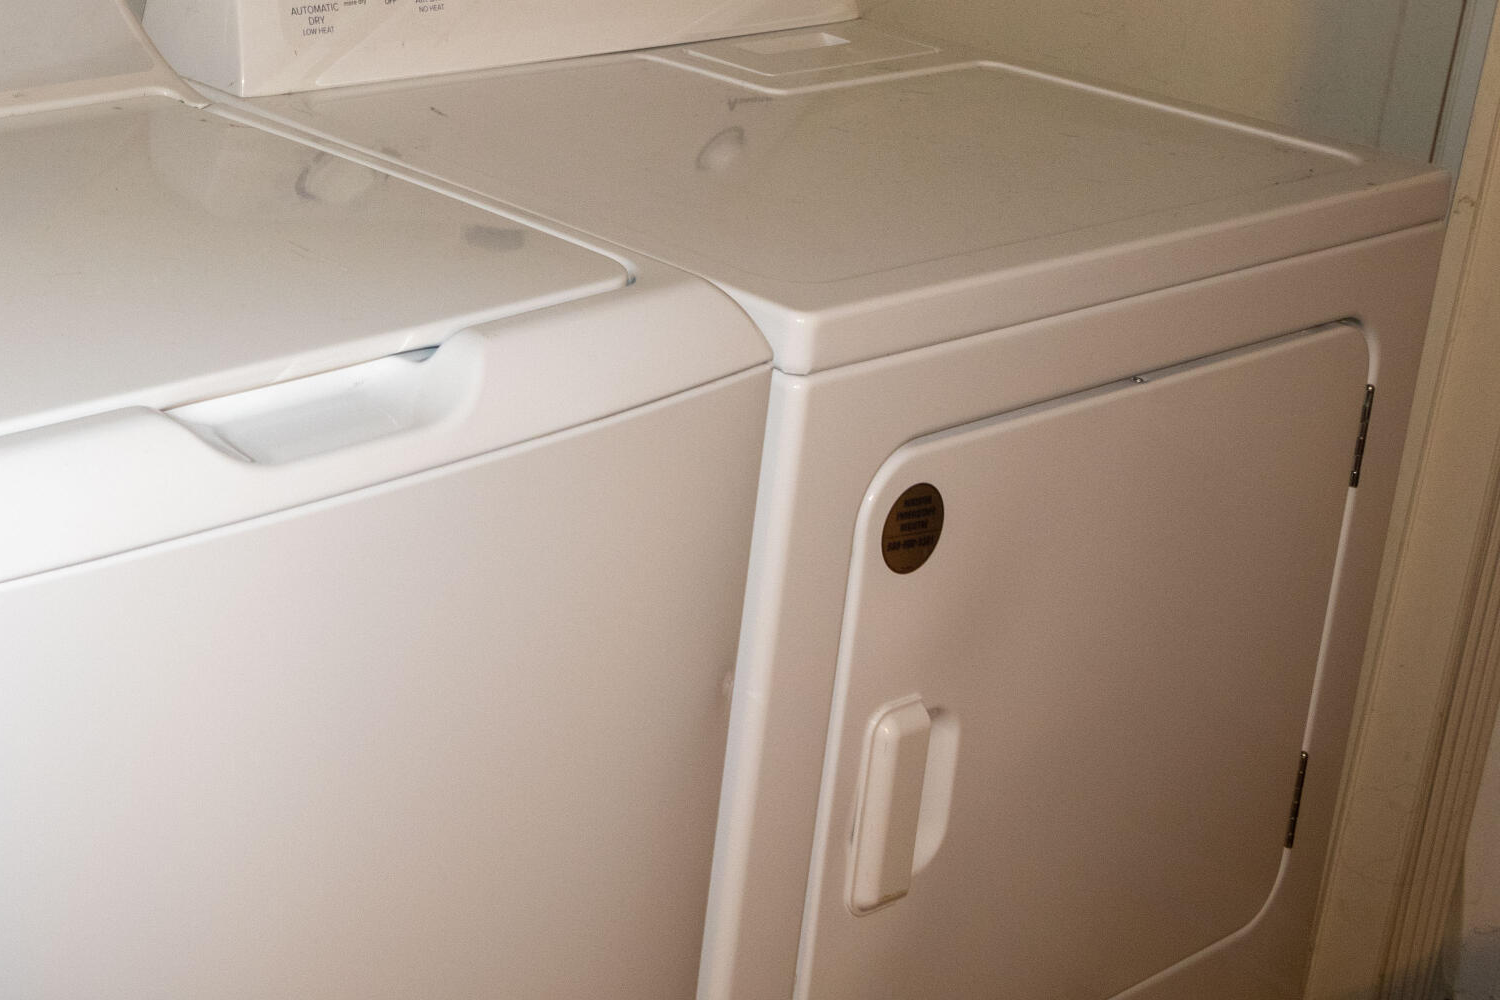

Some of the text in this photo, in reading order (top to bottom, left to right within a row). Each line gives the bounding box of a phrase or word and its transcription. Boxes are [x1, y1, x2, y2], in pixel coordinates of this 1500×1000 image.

[291, 3, 339, 16] AUTOMATIC
[430, 3, 445, 12] HEAT
[308, 15, 325, 26] DRY
[303, 26, 334, 37] LOW HEAT
